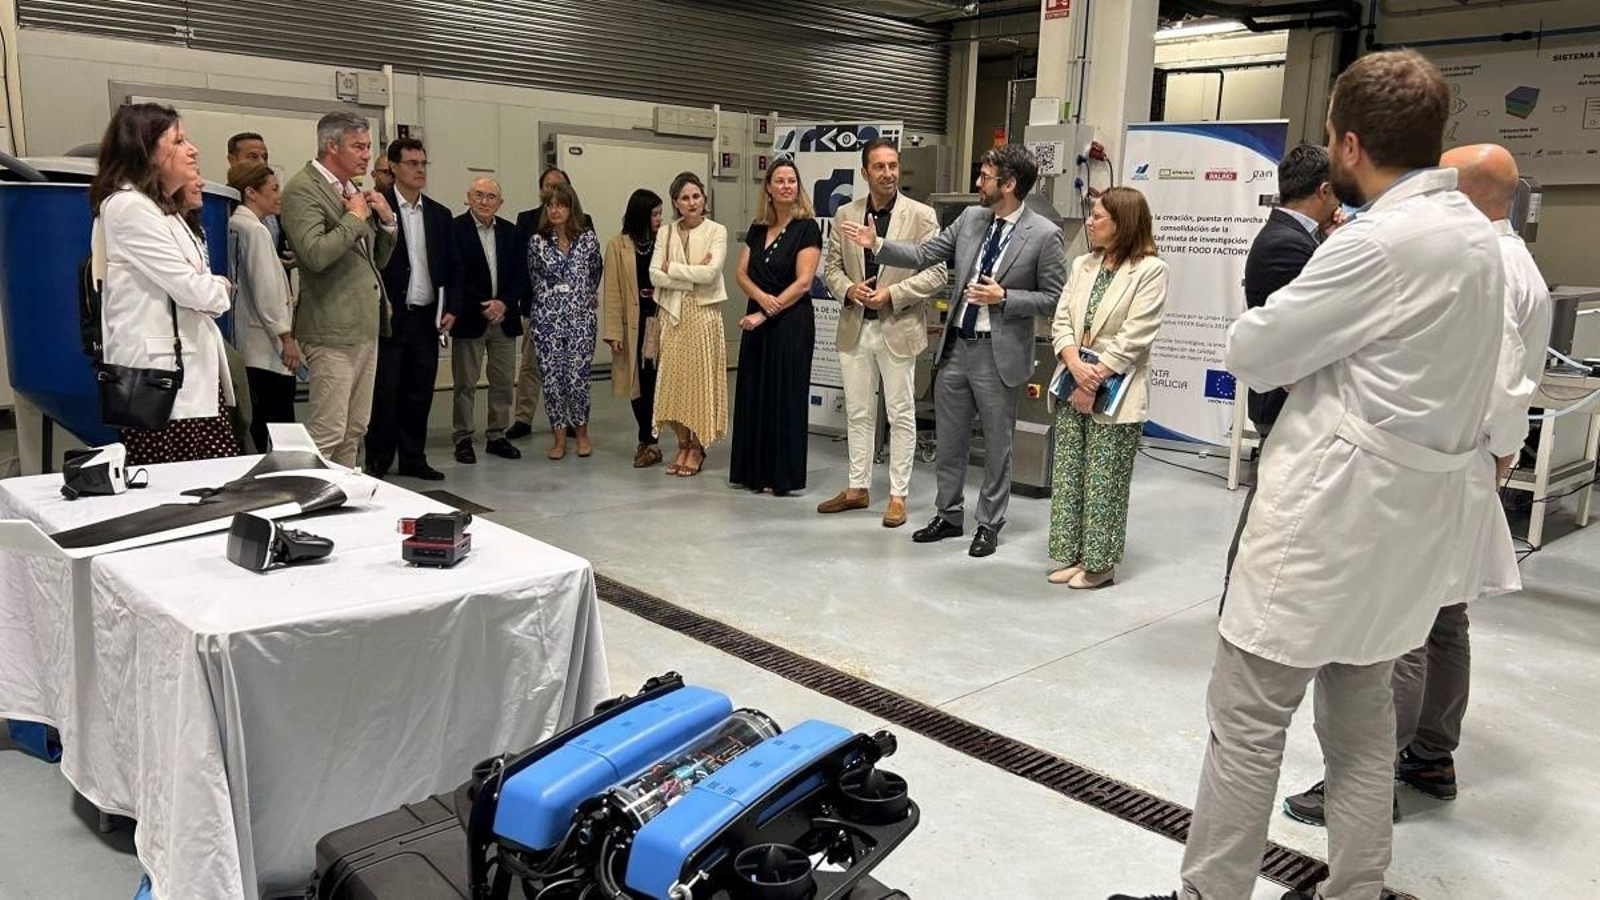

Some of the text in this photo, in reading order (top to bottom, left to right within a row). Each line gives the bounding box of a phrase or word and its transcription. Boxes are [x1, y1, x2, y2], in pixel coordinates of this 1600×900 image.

[1552, 52, 1594, 61] SISTEMA
[1163, 214, 1195, 223] creación,
[1196, 215, 1222, 223] puesta
[1234, 215, 1263, 223] marcha
[1160, 224, 1210, 233] consolidación
[1189, 235, 1198, 243] de
[1199, 236, 1248, 245] investigación
[1156, 245, 1250, 256] FUTURE FOOD FACTORY
[1151, 378, 1188, 390] GALICIA
